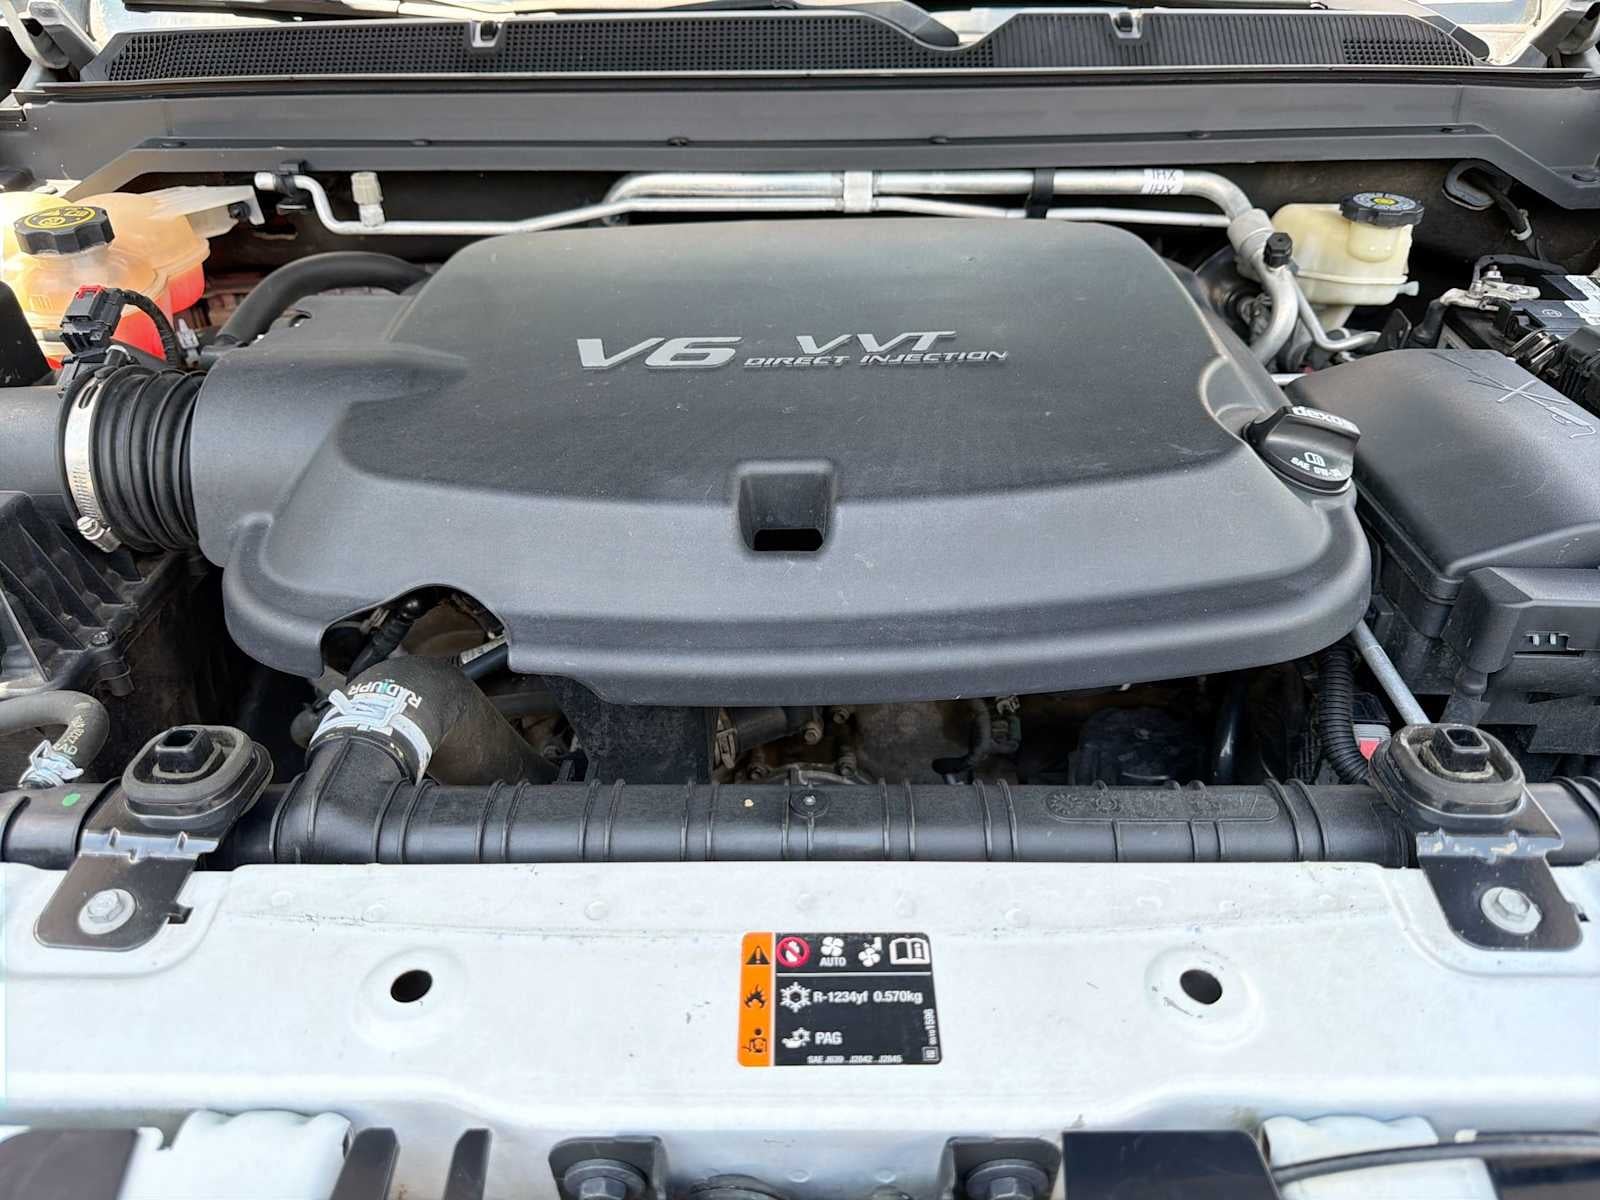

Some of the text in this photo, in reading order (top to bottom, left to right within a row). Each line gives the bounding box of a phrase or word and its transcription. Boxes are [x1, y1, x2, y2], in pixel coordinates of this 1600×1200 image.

[796, 330, 957, 354] VVT
[576, 336, 743, 369] V6
[744, 350, 1009, 368] DIRECT INJECTION
[818, 956, 847, 967] AUTO
[872, 990, 924, 1005] 0.570kg
[814, 1031, 843, 1045] PAG
[806, 1055, 824, 1064] SAE
